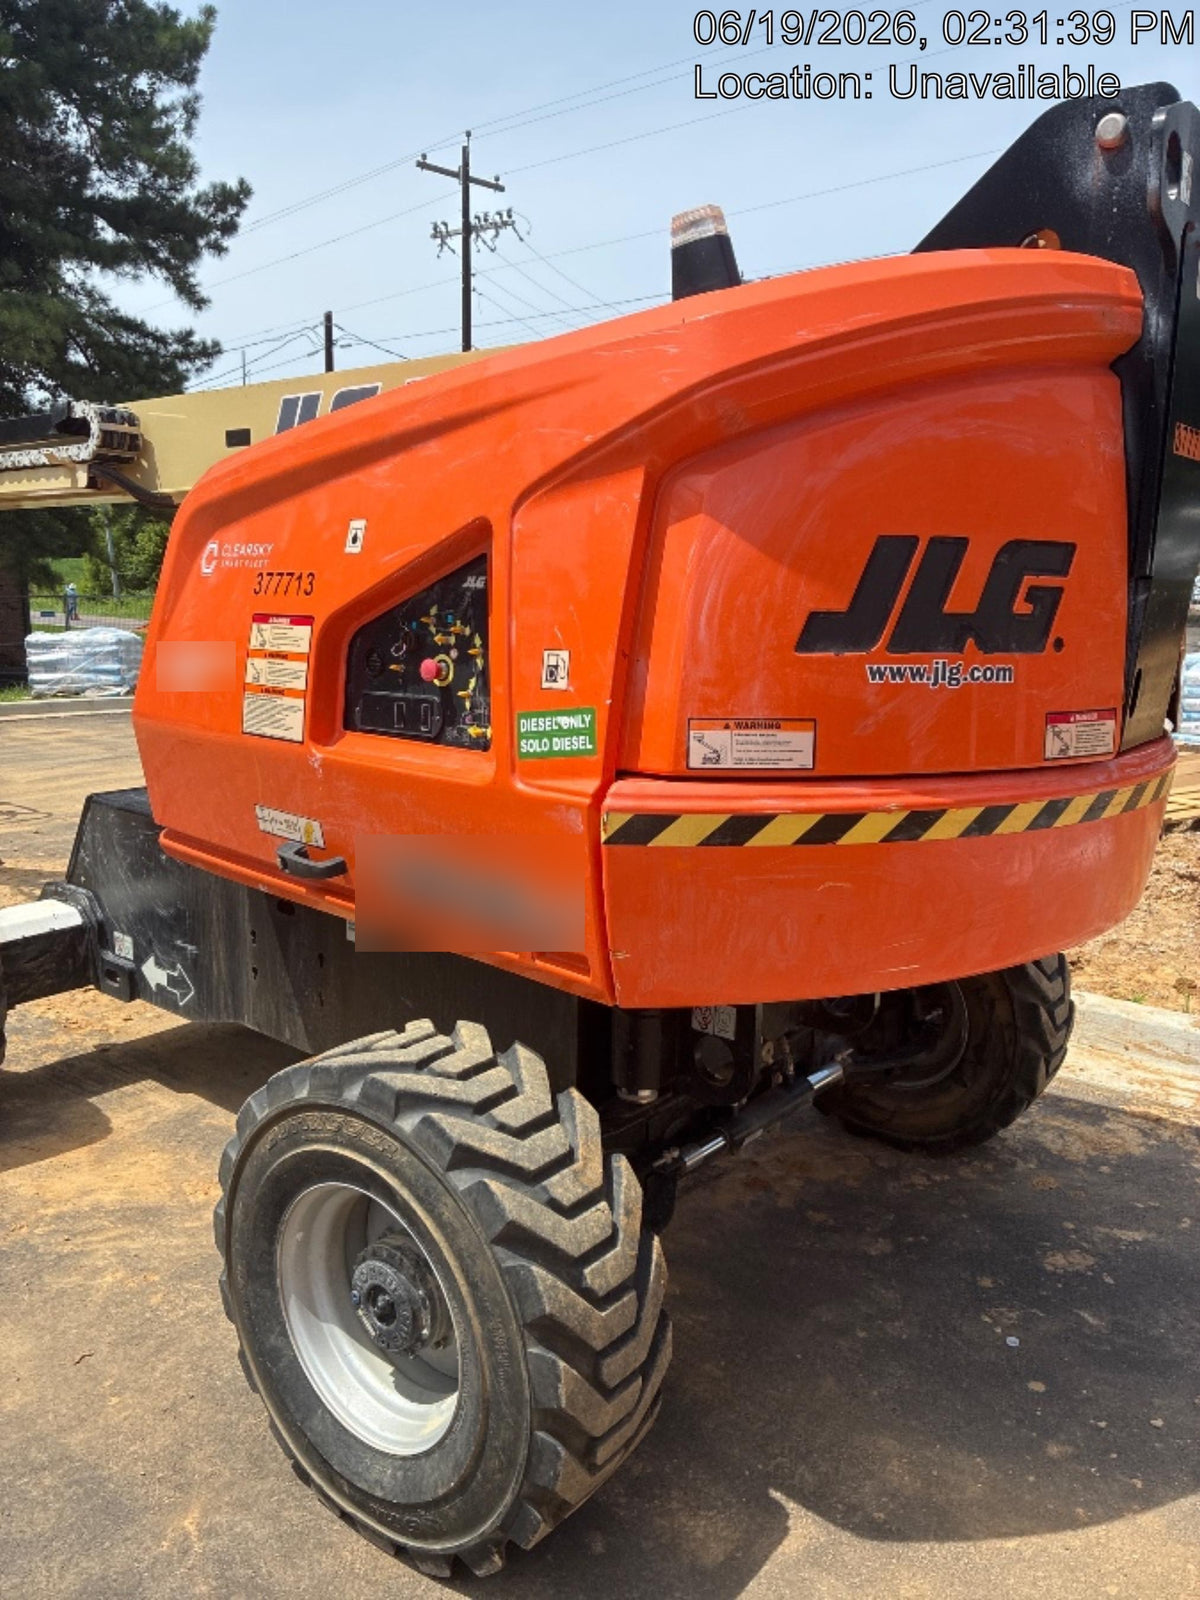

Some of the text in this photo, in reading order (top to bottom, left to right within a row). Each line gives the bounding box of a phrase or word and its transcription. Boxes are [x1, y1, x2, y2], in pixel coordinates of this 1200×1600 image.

[253, 572, 316, 596] 377713
[867, 659, 1014, 687] www.jlg.com
[520, 714, 592, 732] DIESEL ONLY
[734, 721, 781, 730] WARNING
[520, 736, 593, 753] SOLO DIESEL
